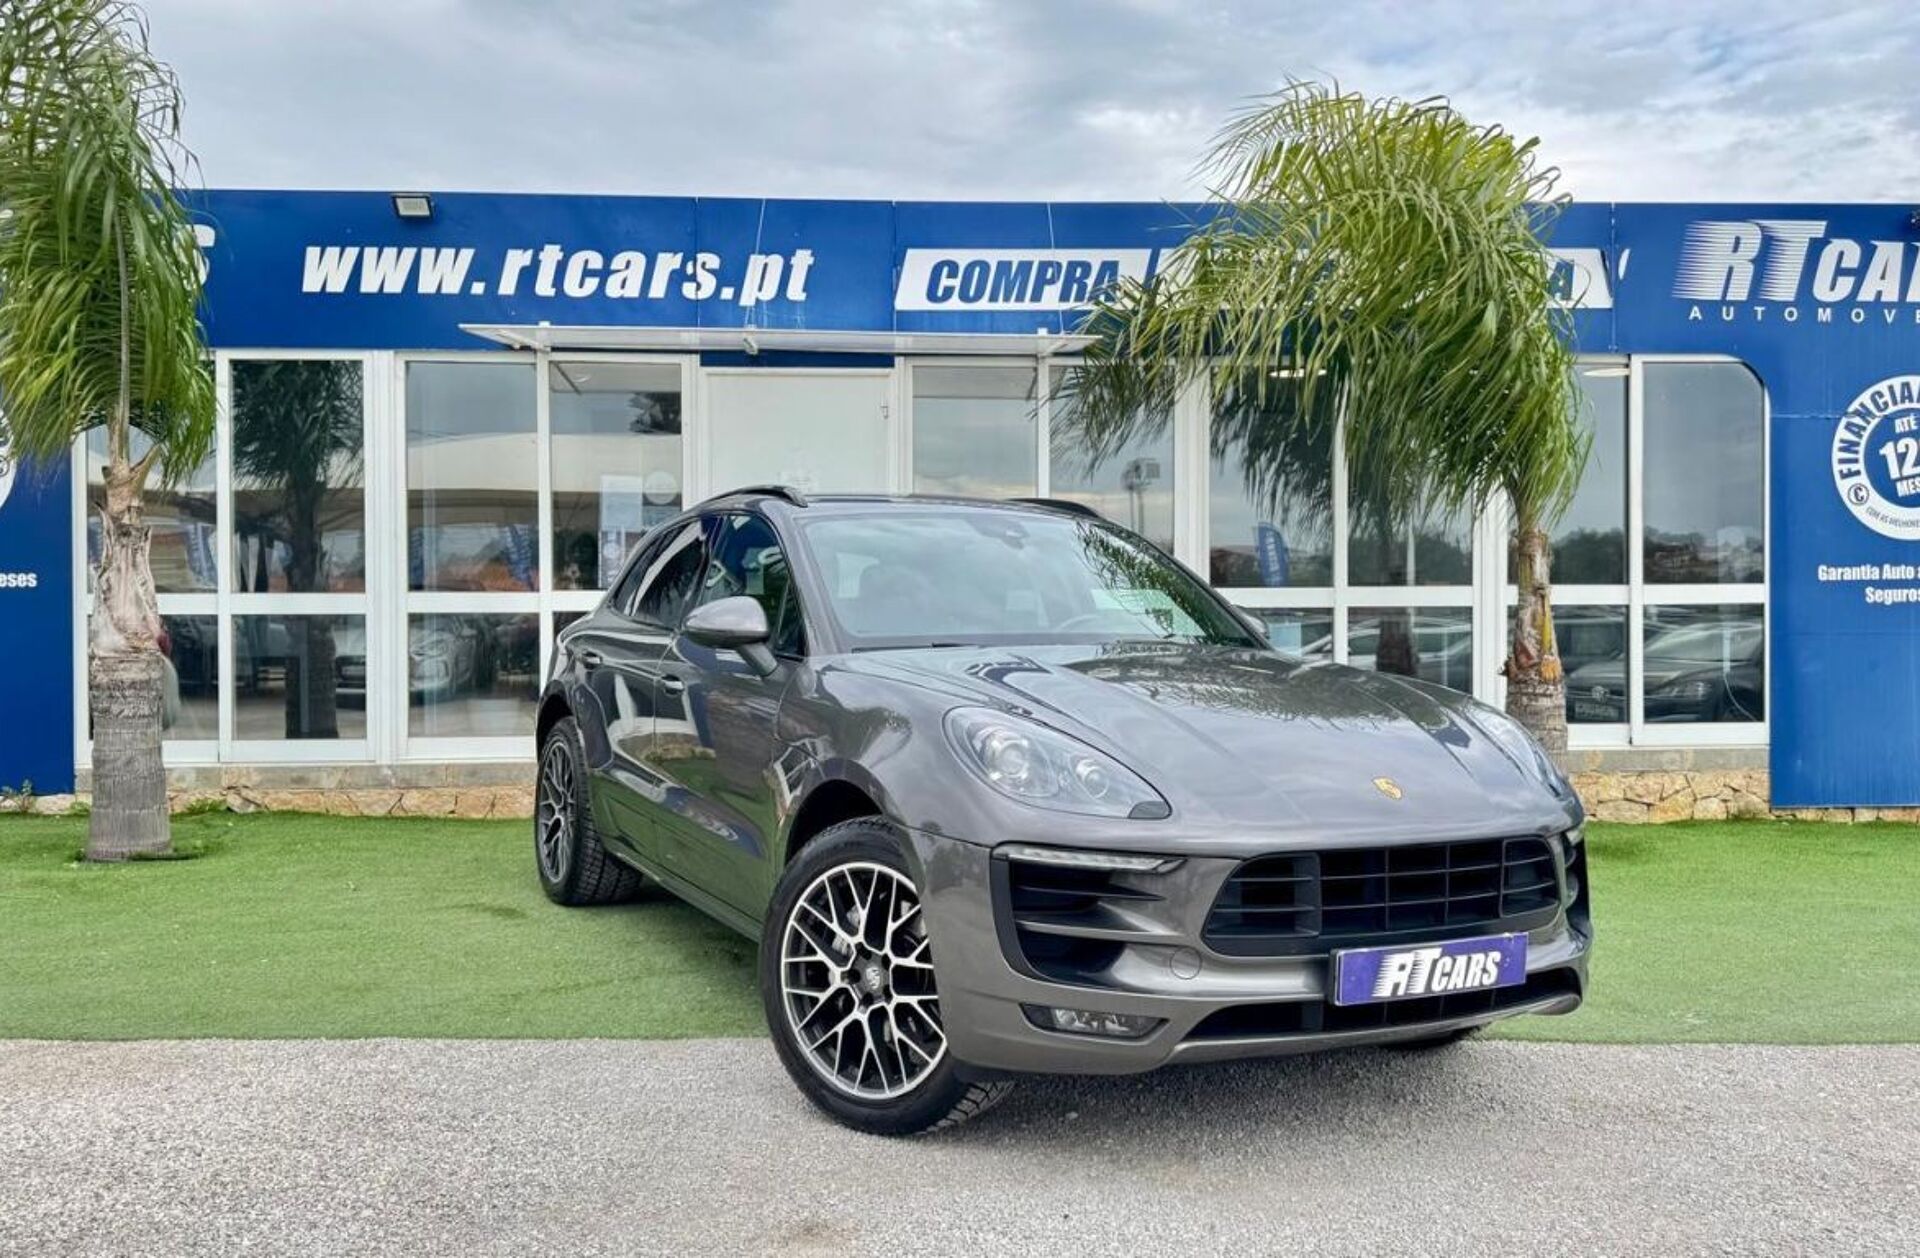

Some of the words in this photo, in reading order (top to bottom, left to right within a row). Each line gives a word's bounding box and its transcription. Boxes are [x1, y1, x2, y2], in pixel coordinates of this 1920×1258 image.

[302, 244, 815, 306] www.rtcars.pt
[926, 259, 1120, 303] COMPRA
[1838, 381, 1920, 480] FINANCIA
[1818, 564, 1880, 581] Garantia
[1882, 563, 1915, 580] Auto
